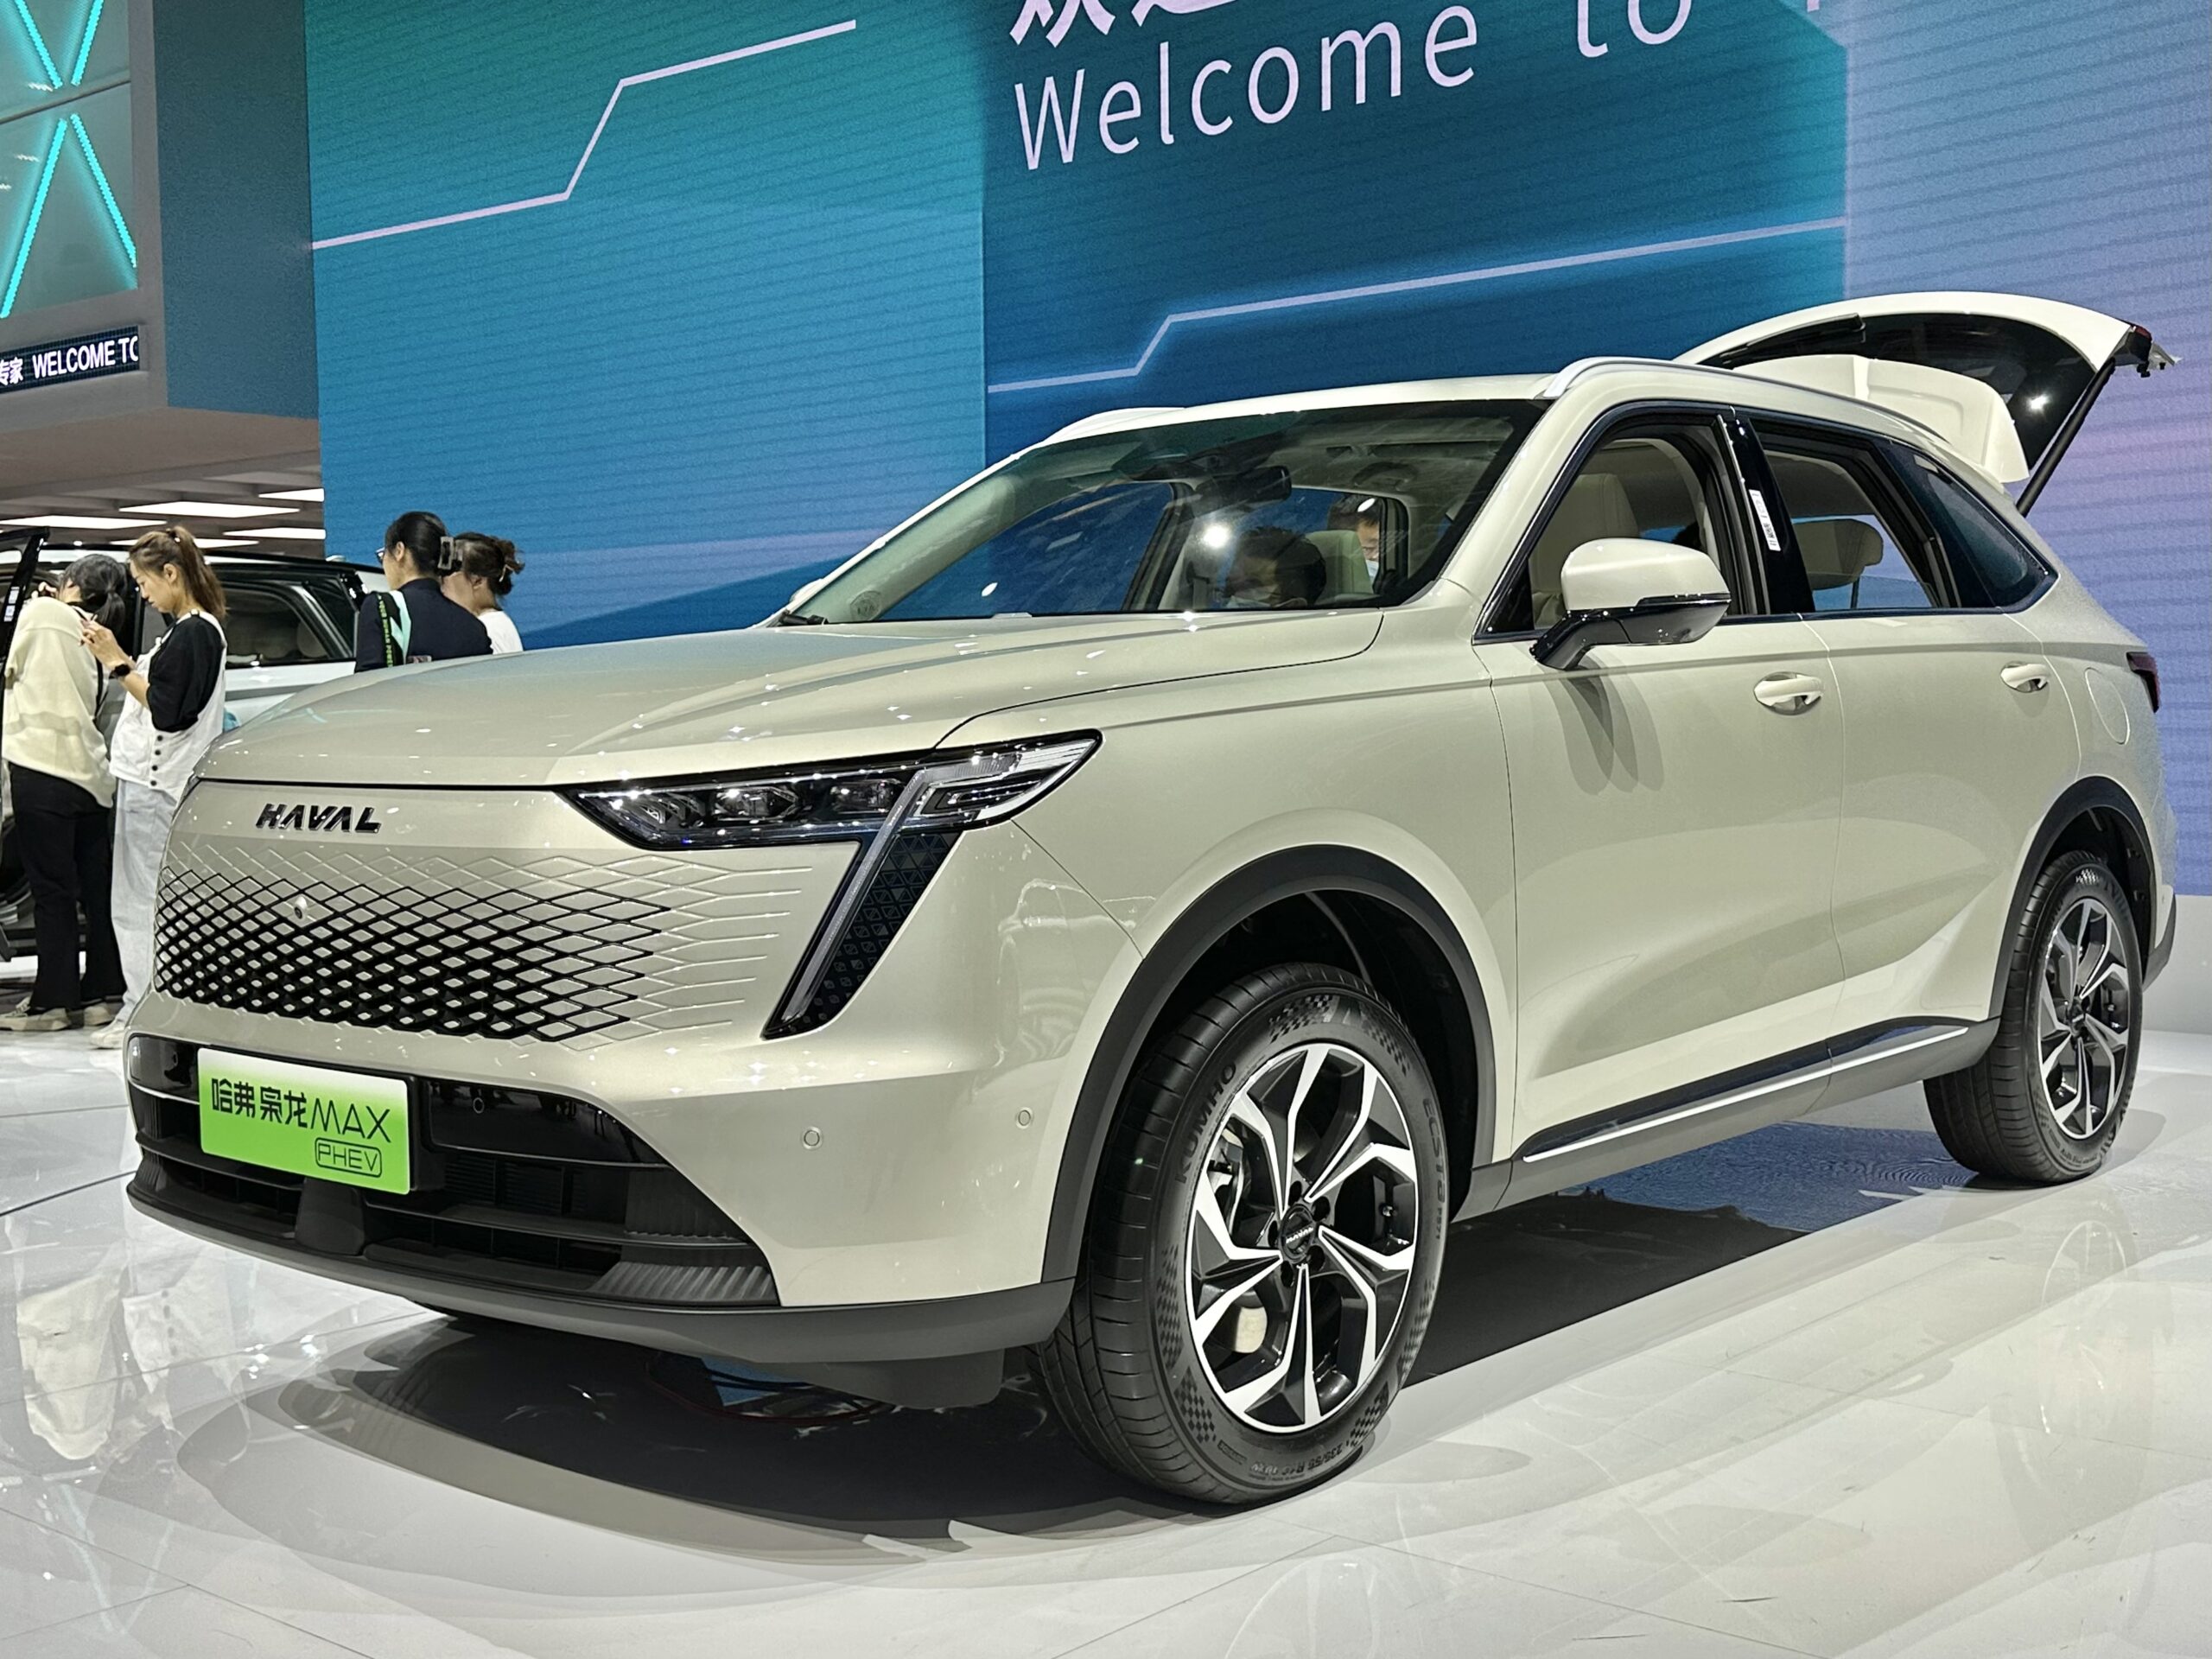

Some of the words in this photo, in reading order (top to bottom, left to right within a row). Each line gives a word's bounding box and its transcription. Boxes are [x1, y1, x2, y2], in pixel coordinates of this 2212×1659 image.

[1014, 5, 1478, 170] Welcome
[32, 340, 117, 378] WELCOME
[256, 803, 382, 834] HAVAL
[1175, 1062, 1236, 1184] KUMHO
[317, 1142, 378, 1172] PHEV
